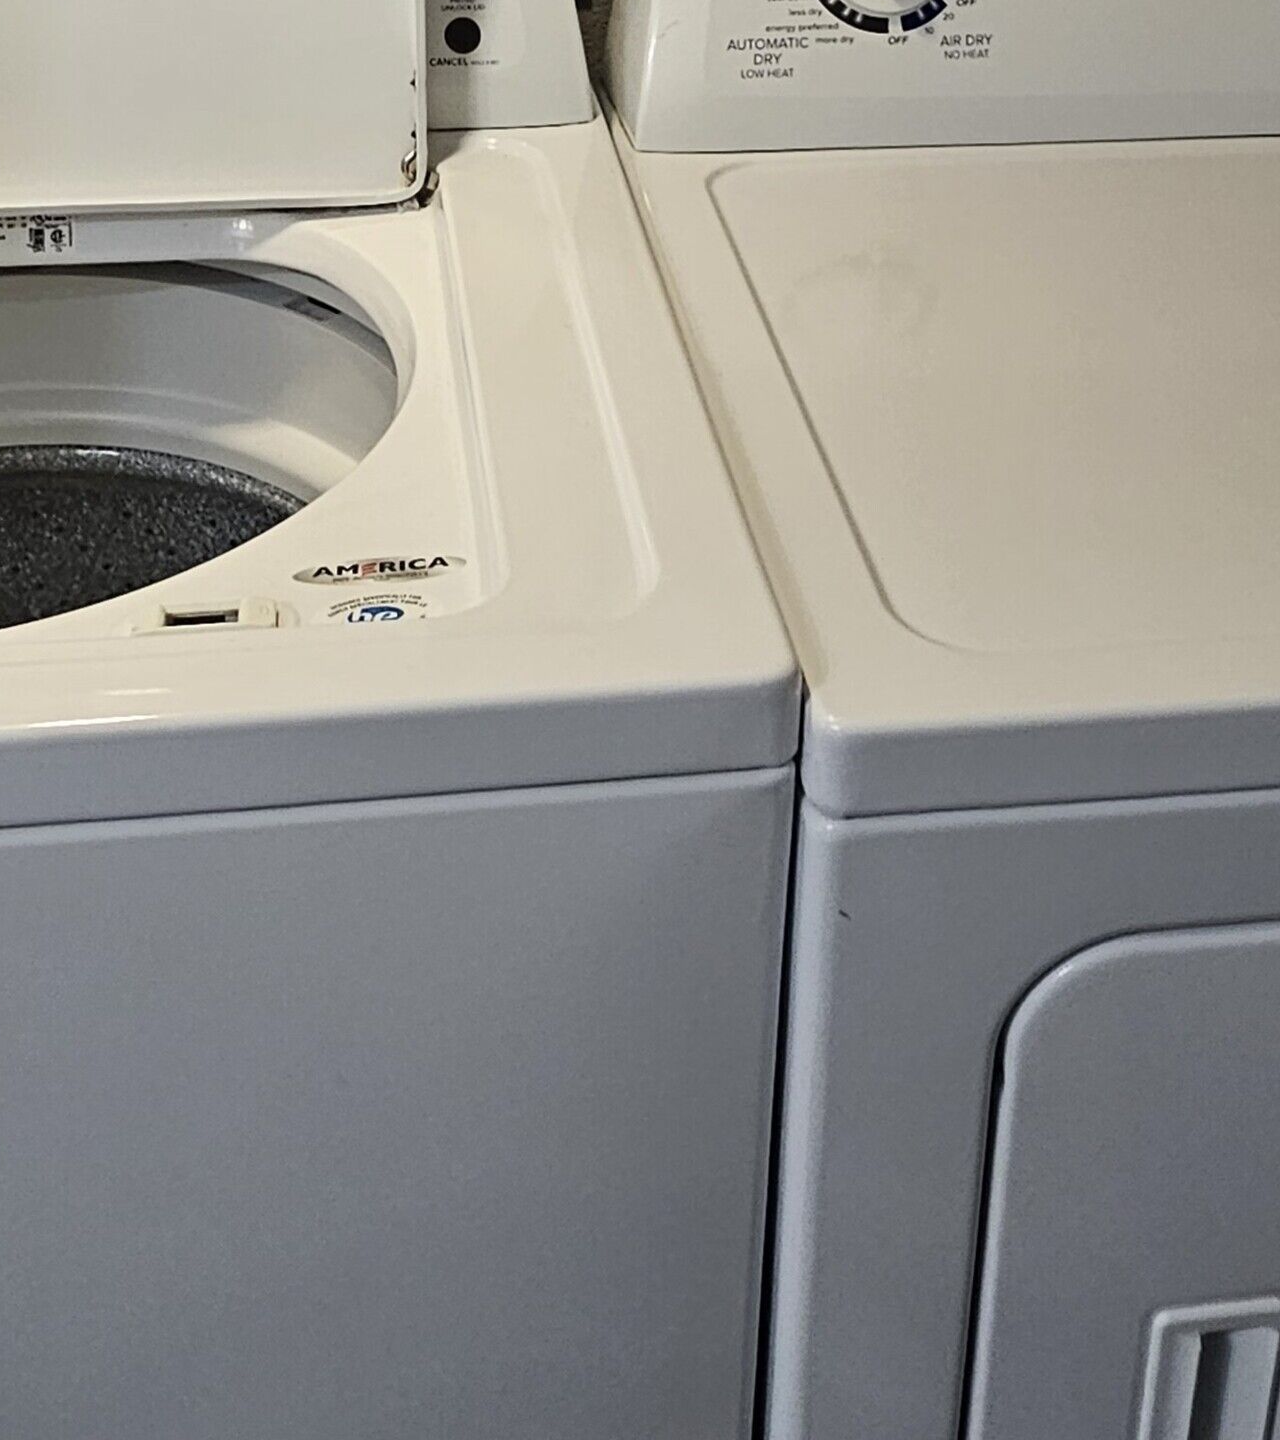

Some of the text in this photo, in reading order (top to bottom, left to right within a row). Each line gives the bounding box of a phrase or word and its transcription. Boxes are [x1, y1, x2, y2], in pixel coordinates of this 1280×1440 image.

[942, 12, 955, 21] 20
[765, 22, 840, 33] energy preferred
[726, 36, 809, 51] AUTOMATIC
[887, 35, 909, 46] OFF
[939, 33, 993, 47] AIR DRY
[753, 53, 782, 66] DRY
[944, 48, 990, 60] NO HEAT
[429, 57, 469, 67] CANCEL
[740, 67, 794, 80] LOW HEAT
[313, 556, 449, 579] AMERICA
